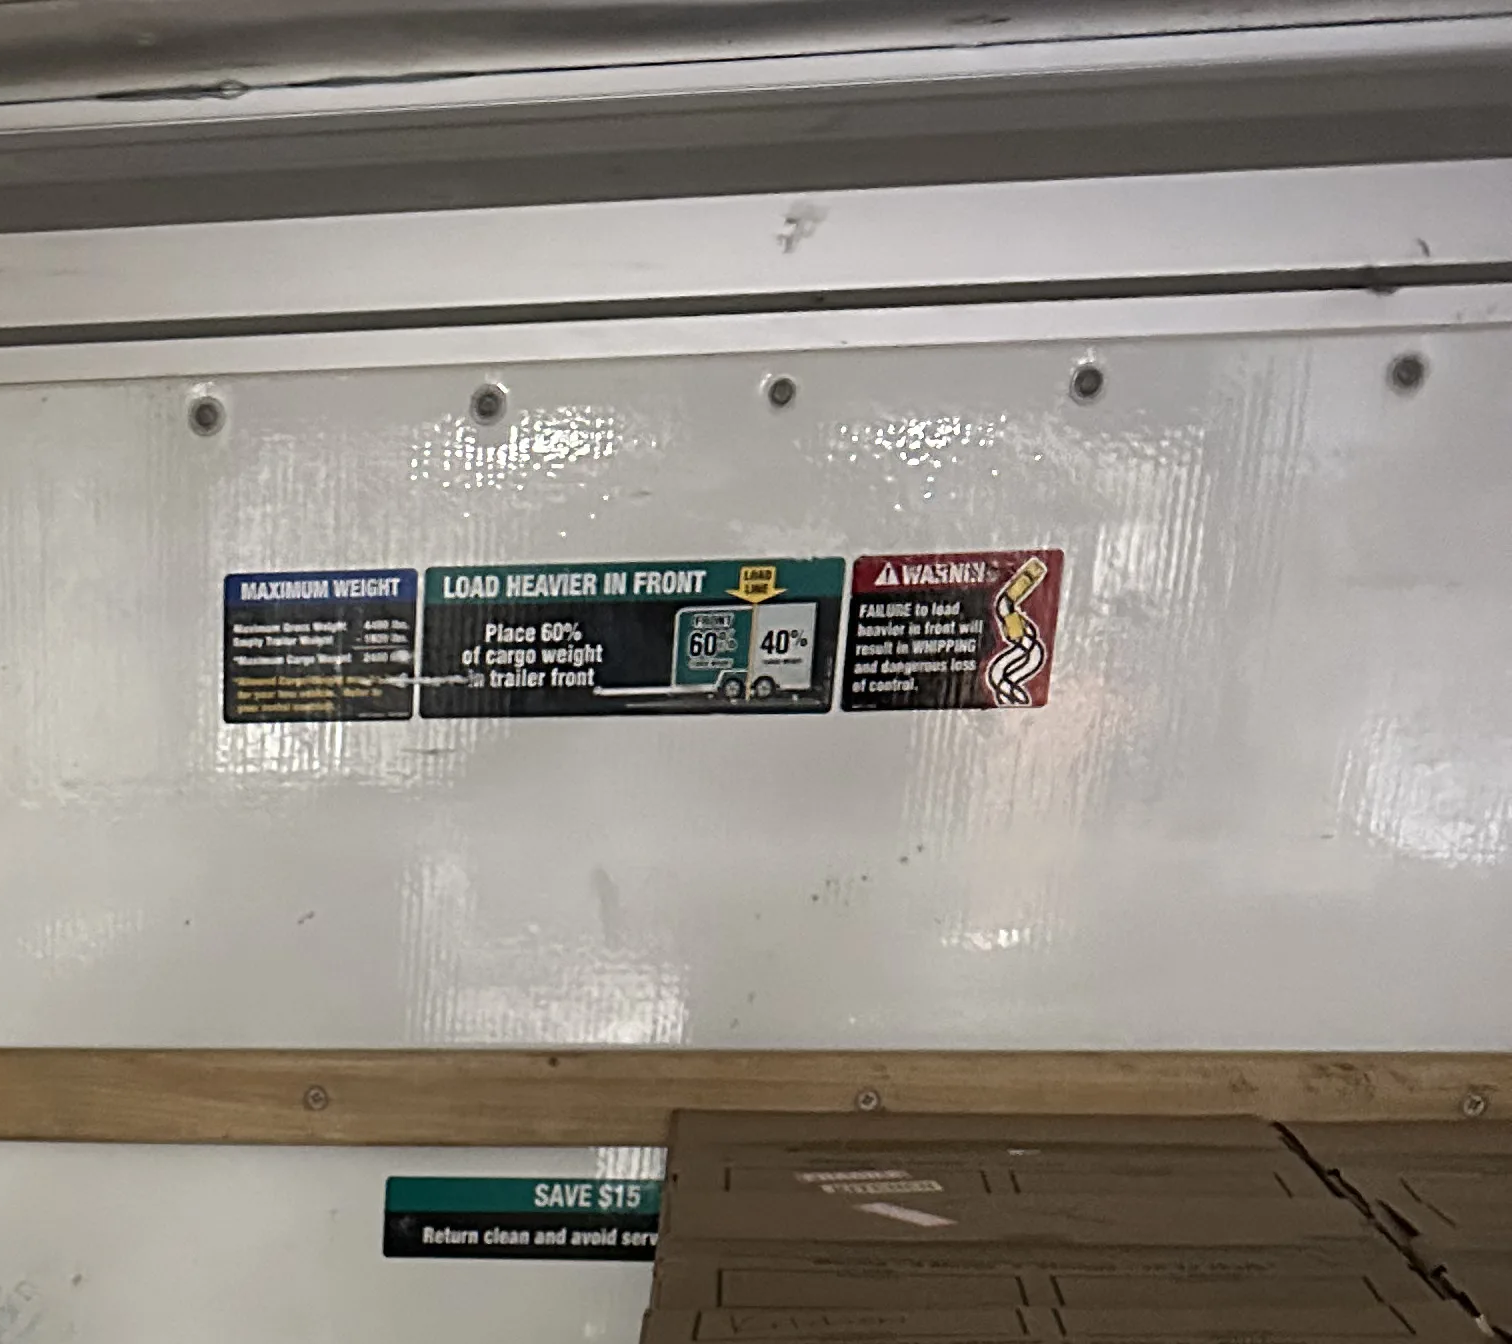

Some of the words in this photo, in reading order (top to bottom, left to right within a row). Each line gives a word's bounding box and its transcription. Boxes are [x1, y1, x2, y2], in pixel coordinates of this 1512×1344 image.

[241, 580, 328, 600] MAXIMUM
[333, 578, 400, 598] WEIGHT
[443, 574, 499, 598] LOAD
[506, 572, 597, 598] HEAVIER
[603, 571, 626, 595] IN
[632, 570, 706, 595] FRONT
[859, 602, 912, 618] FAILURE
[915, 603, 929, 617] to
[932, 601, 960, 616] load
[485, 623, 536, 644] Place
[541, 622, 582, 643] 60%
[857, 621, 905, 637] heavier
[908, 622, 921, 635] in
[924, 621, 956, 635] front
[959, 619, 984, 634] will
[760, 629, 808, 655] 40%
[855, 640, 893, 656] result
[896, 640, 909, 654] in
[912, 638, 977, 655] WHIPPING
[461, 647, 481, 664] of
[486, 648, 537, 668] cargo
[542, 643, 603, 668] weight
[467, 670, 485, 688] in
[490, 668, 546, 687] trailer
[551, 668, 595, 688] front
[853, 659, 879, 675] and
[881, 659, 948, 676] dangerous
[951, 659, 977, 672] loss
[852, 677, 867, 693] of
[869, 676, 919, 693] control.
[534, 1183, 592, 1208] SAVE
[598, 1184, 641, 1211] $15
[422, 1225, 479, 1245] Return
[483, 1226, 530, 1246] clean
[534, 1226, 567, 1246] and
[570, 1227, 618, 1247] avoid
[621, 1231, 660, 1247] serv
